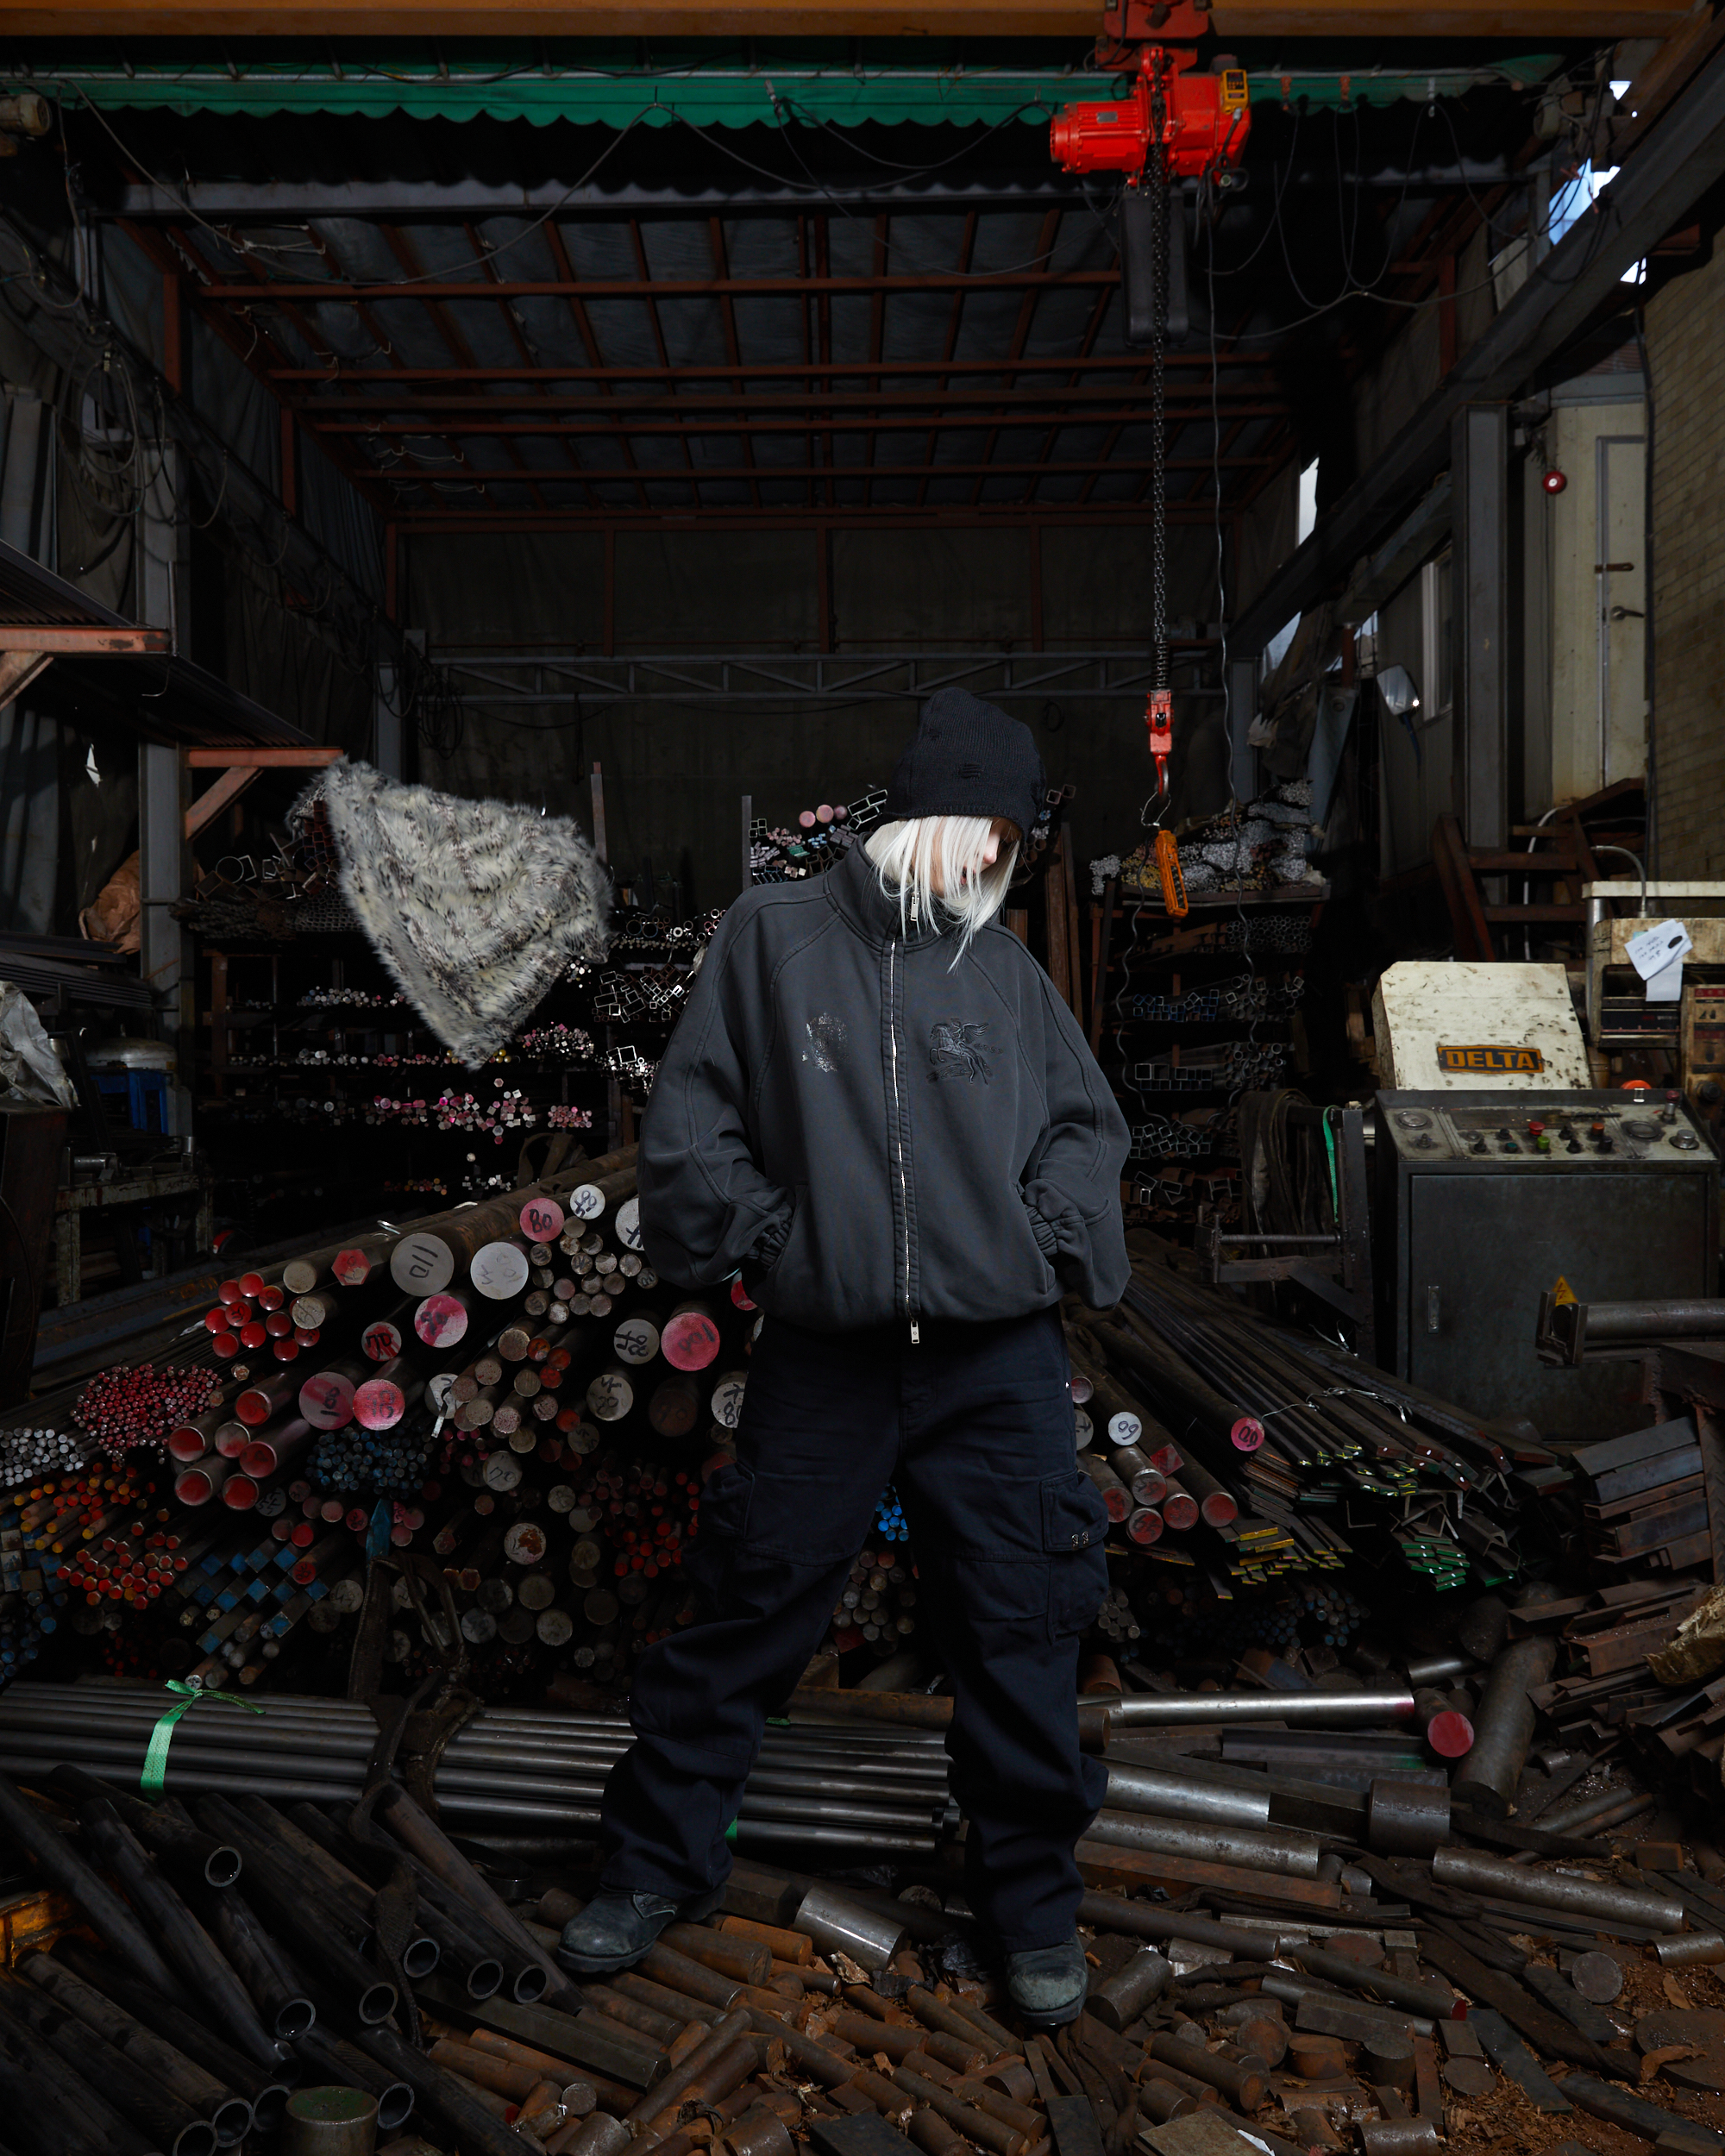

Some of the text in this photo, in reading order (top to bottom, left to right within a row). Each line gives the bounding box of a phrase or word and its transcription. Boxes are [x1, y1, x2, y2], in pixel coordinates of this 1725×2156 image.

[1446, 1050, 1534, 1069] DELTA
[530, 1208, 553, 1233] 80
[366, 1332, 392, 1360] 70
